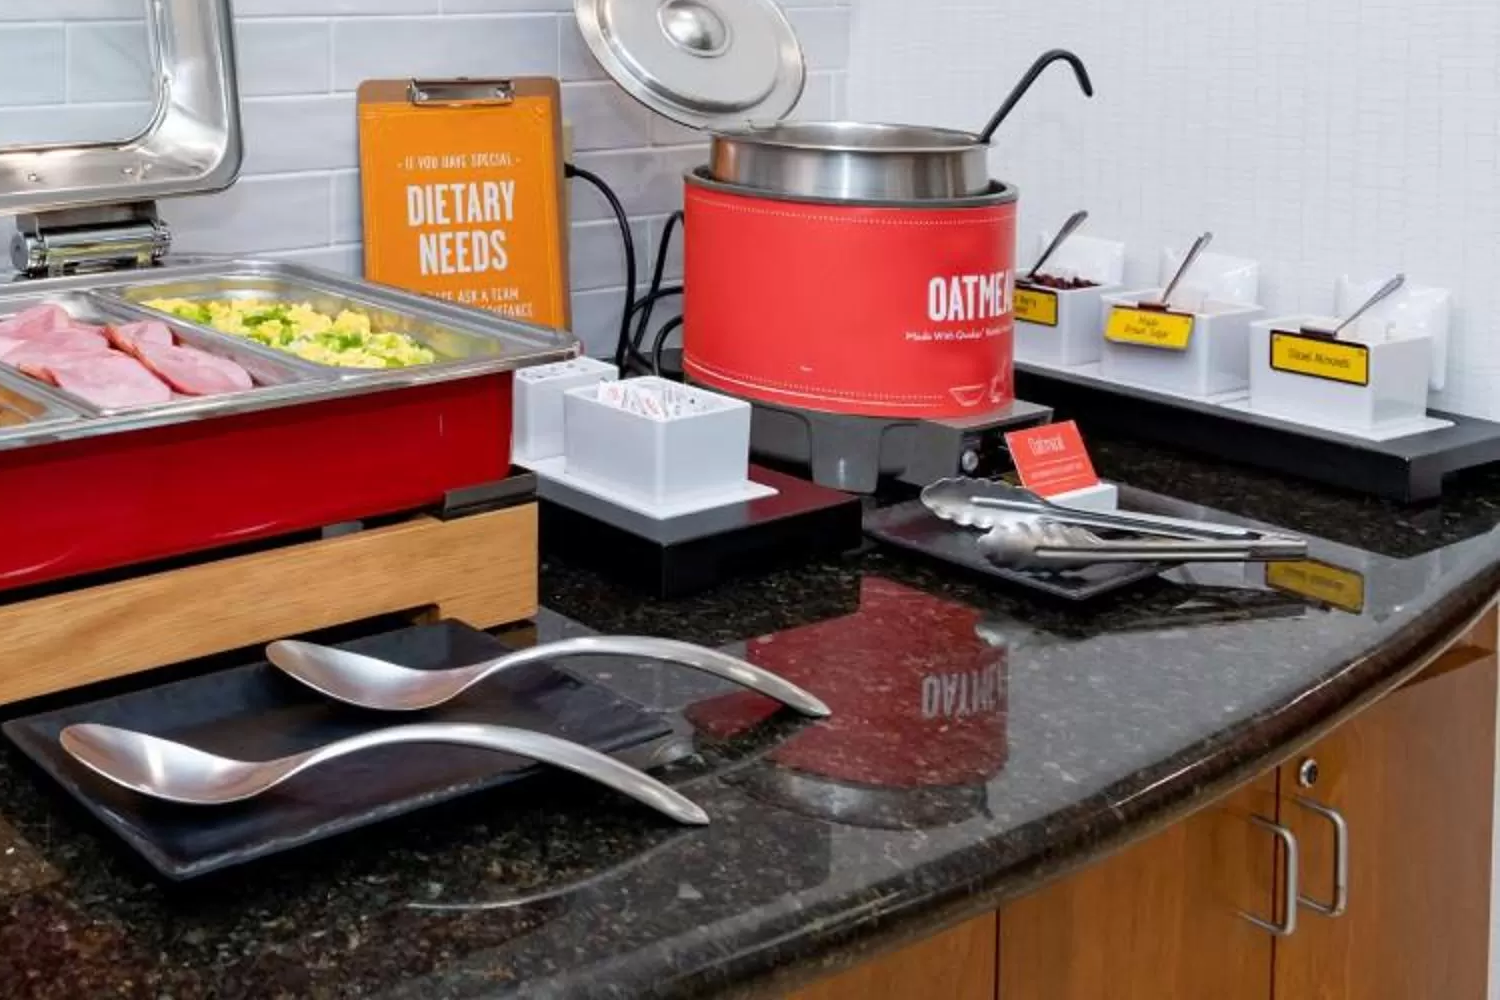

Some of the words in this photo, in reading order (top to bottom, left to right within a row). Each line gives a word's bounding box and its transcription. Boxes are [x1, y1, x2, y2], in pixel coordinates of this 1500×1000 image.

[470, 151, 512, 168] SPECIAL
[406, 179, 516, 227] DIETARY
[418, 229, 509, 276] NEEDS
[928, 268, 1013, 322] OATMEA
